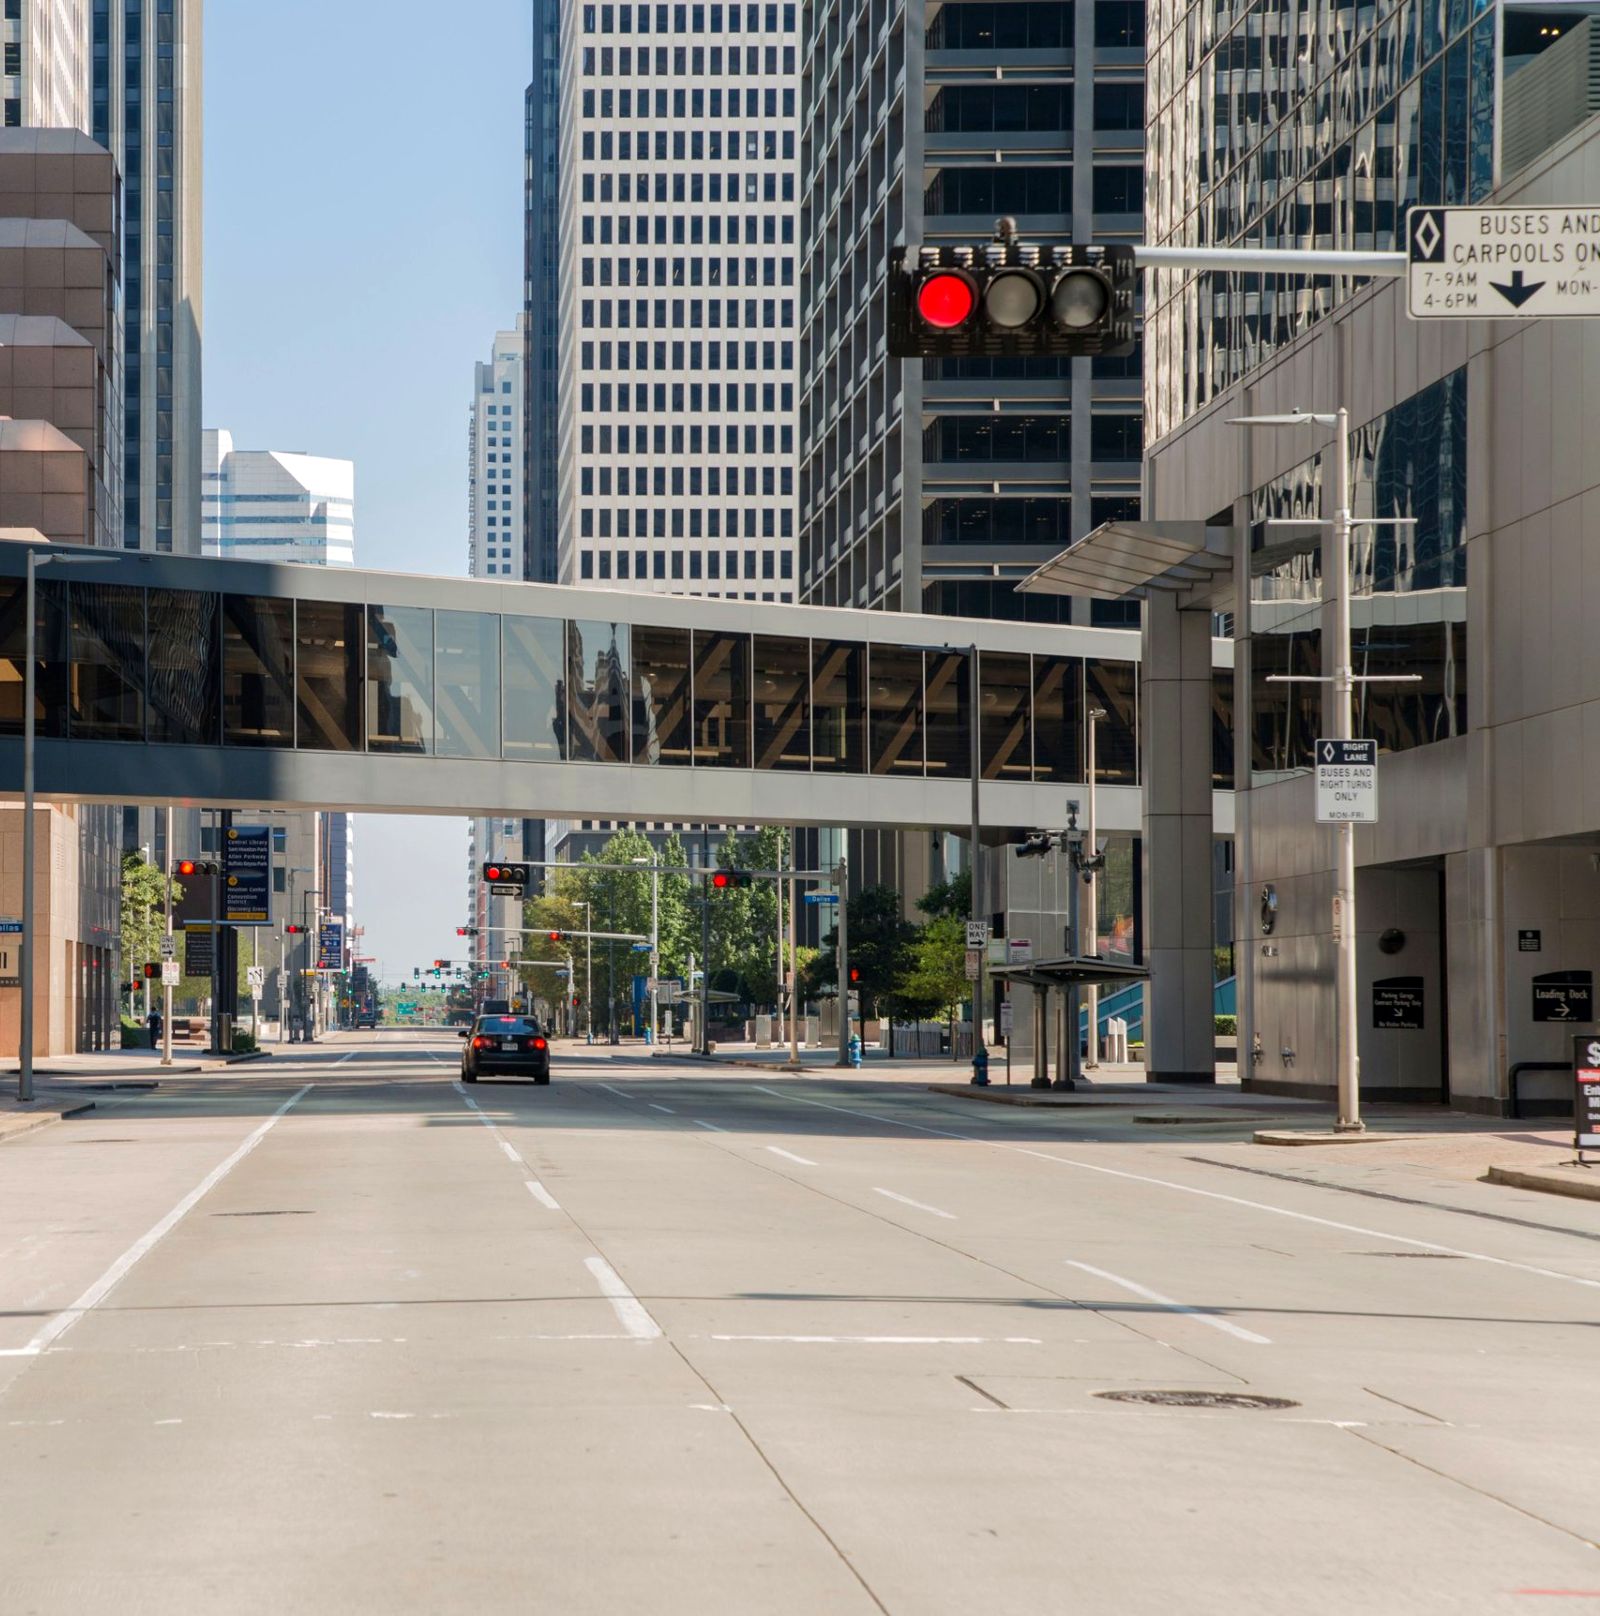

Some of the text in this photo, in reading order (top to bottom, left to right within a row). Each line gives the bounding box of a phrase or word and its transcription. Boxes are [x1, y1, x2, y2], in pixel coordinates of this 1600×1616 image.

[1480, 215, 1600, 235] BUSES AND
[1453, 243, 1565, 263] CARPOOLS
[1424, 272, 1478, 287] 7-9AM
[1424, 293, 1478, 308] 4-6PM
[1342, 743, 1370, 751] RIGHT
[1344, 753, 1368, 761] LANE
[1320, 768, 1372, 777] BUSES AND
[1320, 780, 1373, 789] RIGHT TURNS
[1334, 792, 1358, 801] ONLY
[1329, 811, 1365, 819] MON-FRI
[968, 923, 985, 931] ONE
[1536, 988, 1588, 1002] Loading Dock
